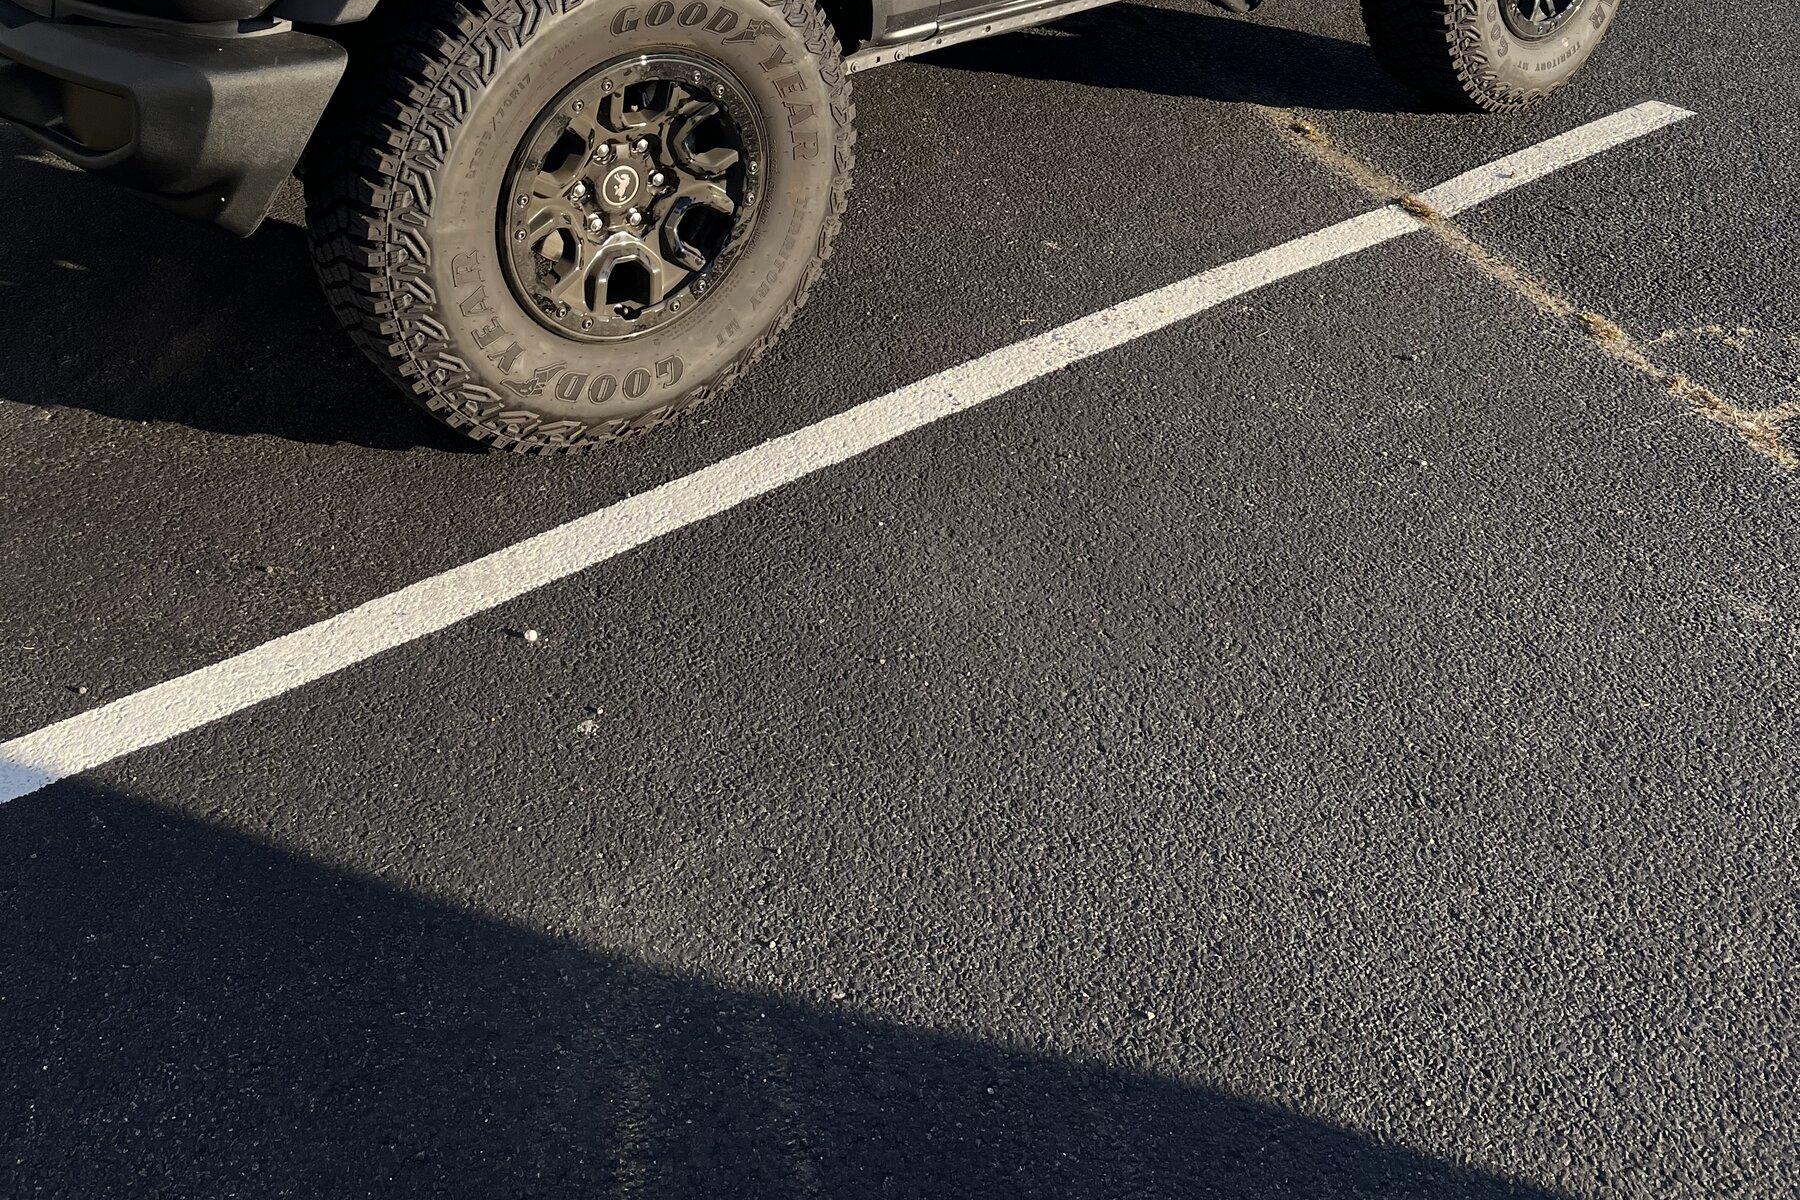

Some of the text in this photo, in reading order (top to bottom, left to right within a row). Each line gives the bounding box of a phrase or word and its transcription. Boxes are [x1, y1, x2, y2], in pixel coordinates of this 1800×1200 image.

[609, 0, 821, 161] GOODYEAR
[1535, 41, 1581, 71] TERRITORY
[450, 249, 686, 403] GOODYEAR
